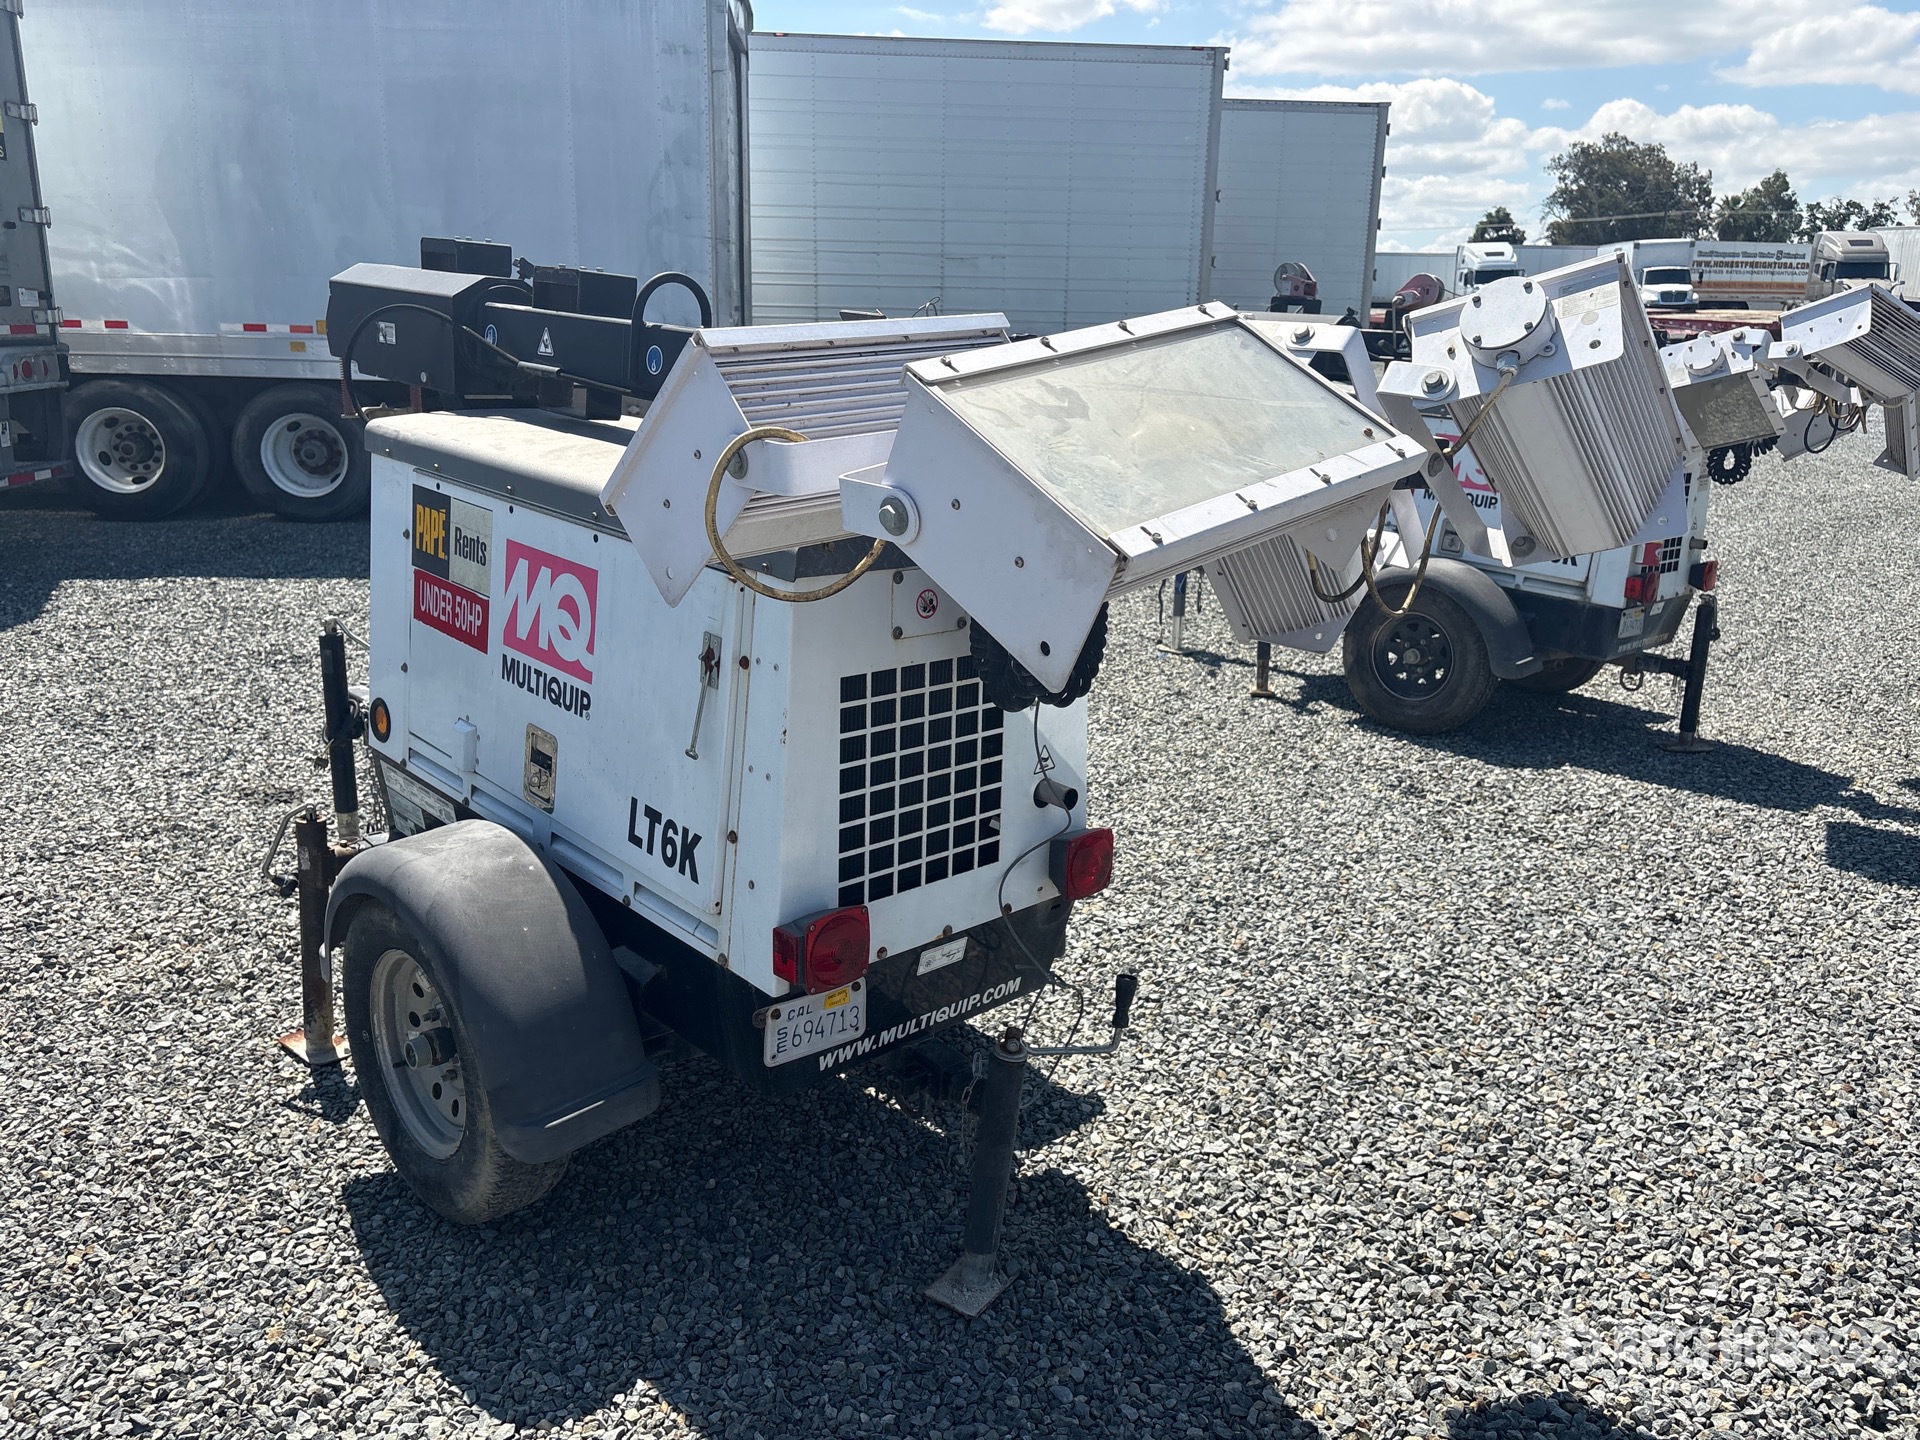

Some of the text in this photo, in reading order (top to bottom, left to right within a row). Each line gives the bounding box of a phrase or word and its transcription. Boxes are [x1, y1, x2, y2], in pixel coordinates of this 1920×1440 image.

[1775, 250, 1784, 261] 5
[454, 526, 487, 567] Rents
[419, 579, 483, 637] UNDER 50HP
[503, 557, 595, 672] MQ
[501, 653, 592, 719] MULTIQUIP
[628, 796, 703, 885] LT6K
[787, 1004, 813, 1021] CAL
[791, 1005, 860, 1048] 694713
[818, 976, 1022, 1071] WWW.MULTIQUIP.COM
